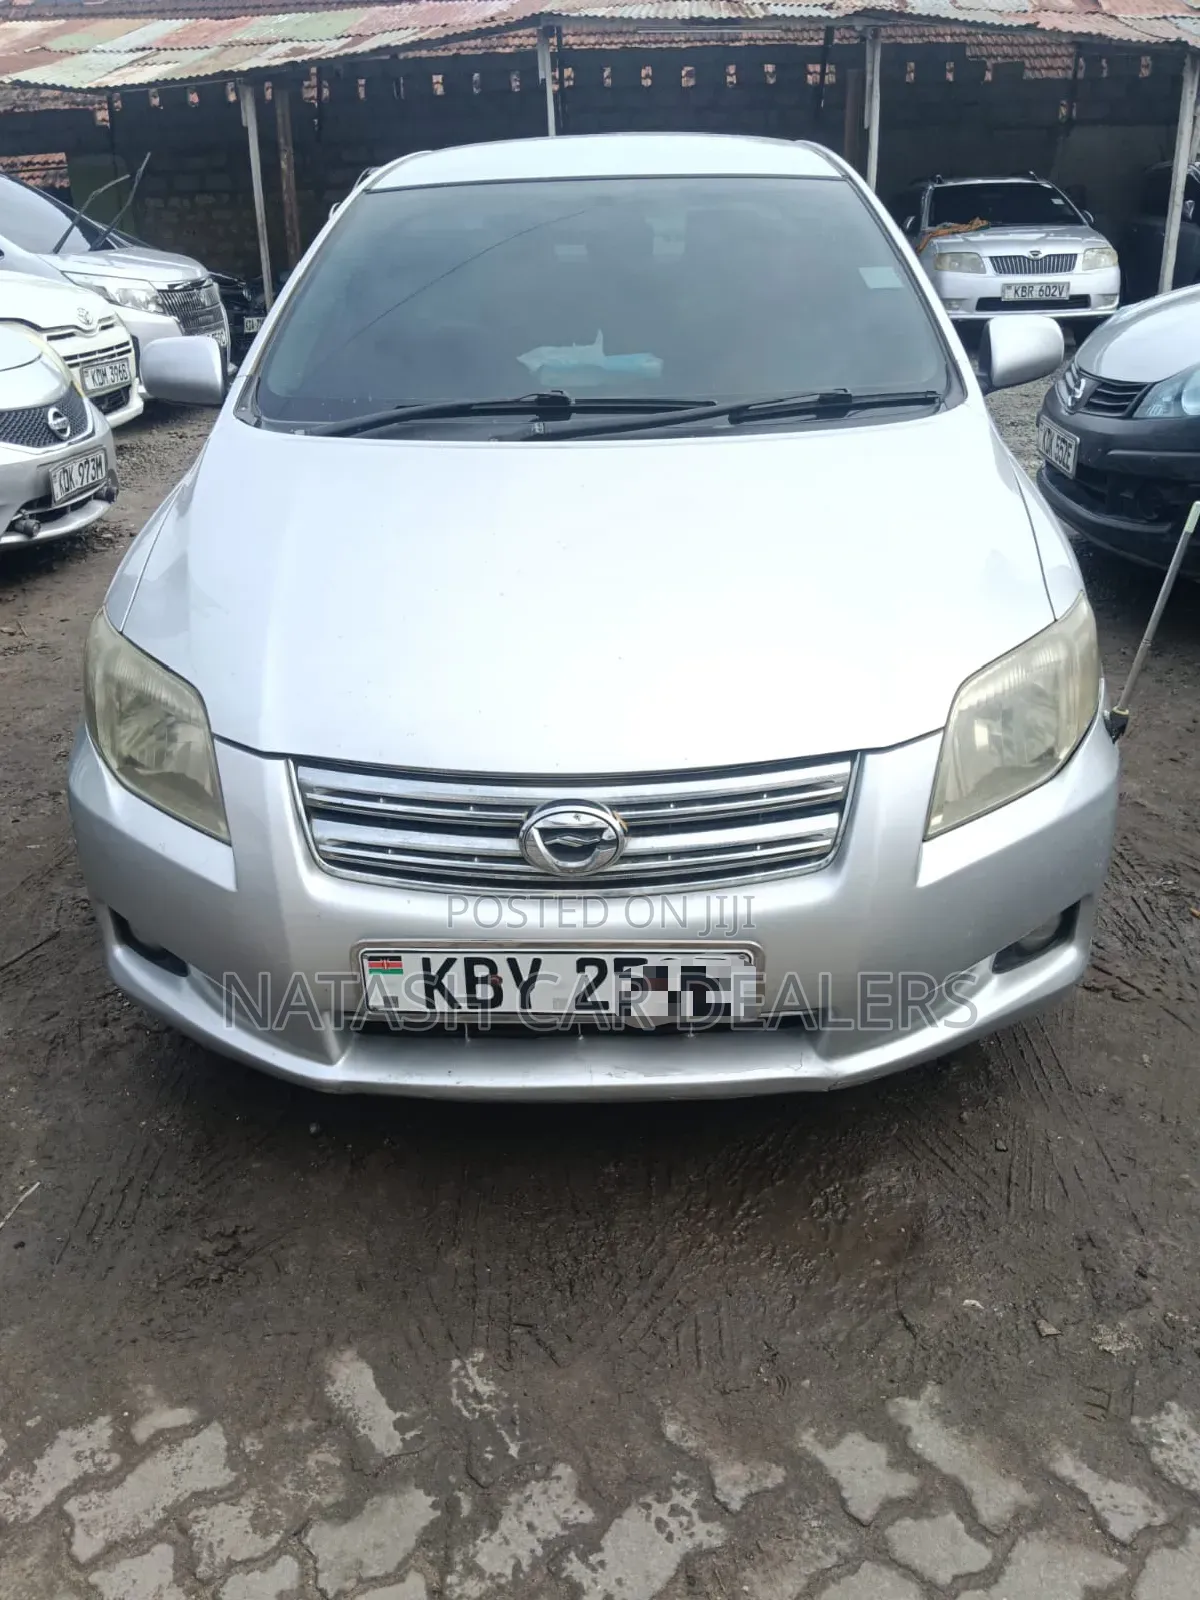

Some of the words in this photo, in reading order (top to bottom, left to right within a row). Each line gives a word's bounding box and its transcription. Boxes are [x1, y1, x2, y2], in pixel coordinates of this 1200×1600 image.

[1014, 285, 1034, 298] KBR
[1038, 285, 1065, 298] 602V
[60, 465, 76, 496] KDK
[78, 454, 103, 486] 973M
[421, 956, 543, 1010] KBY
